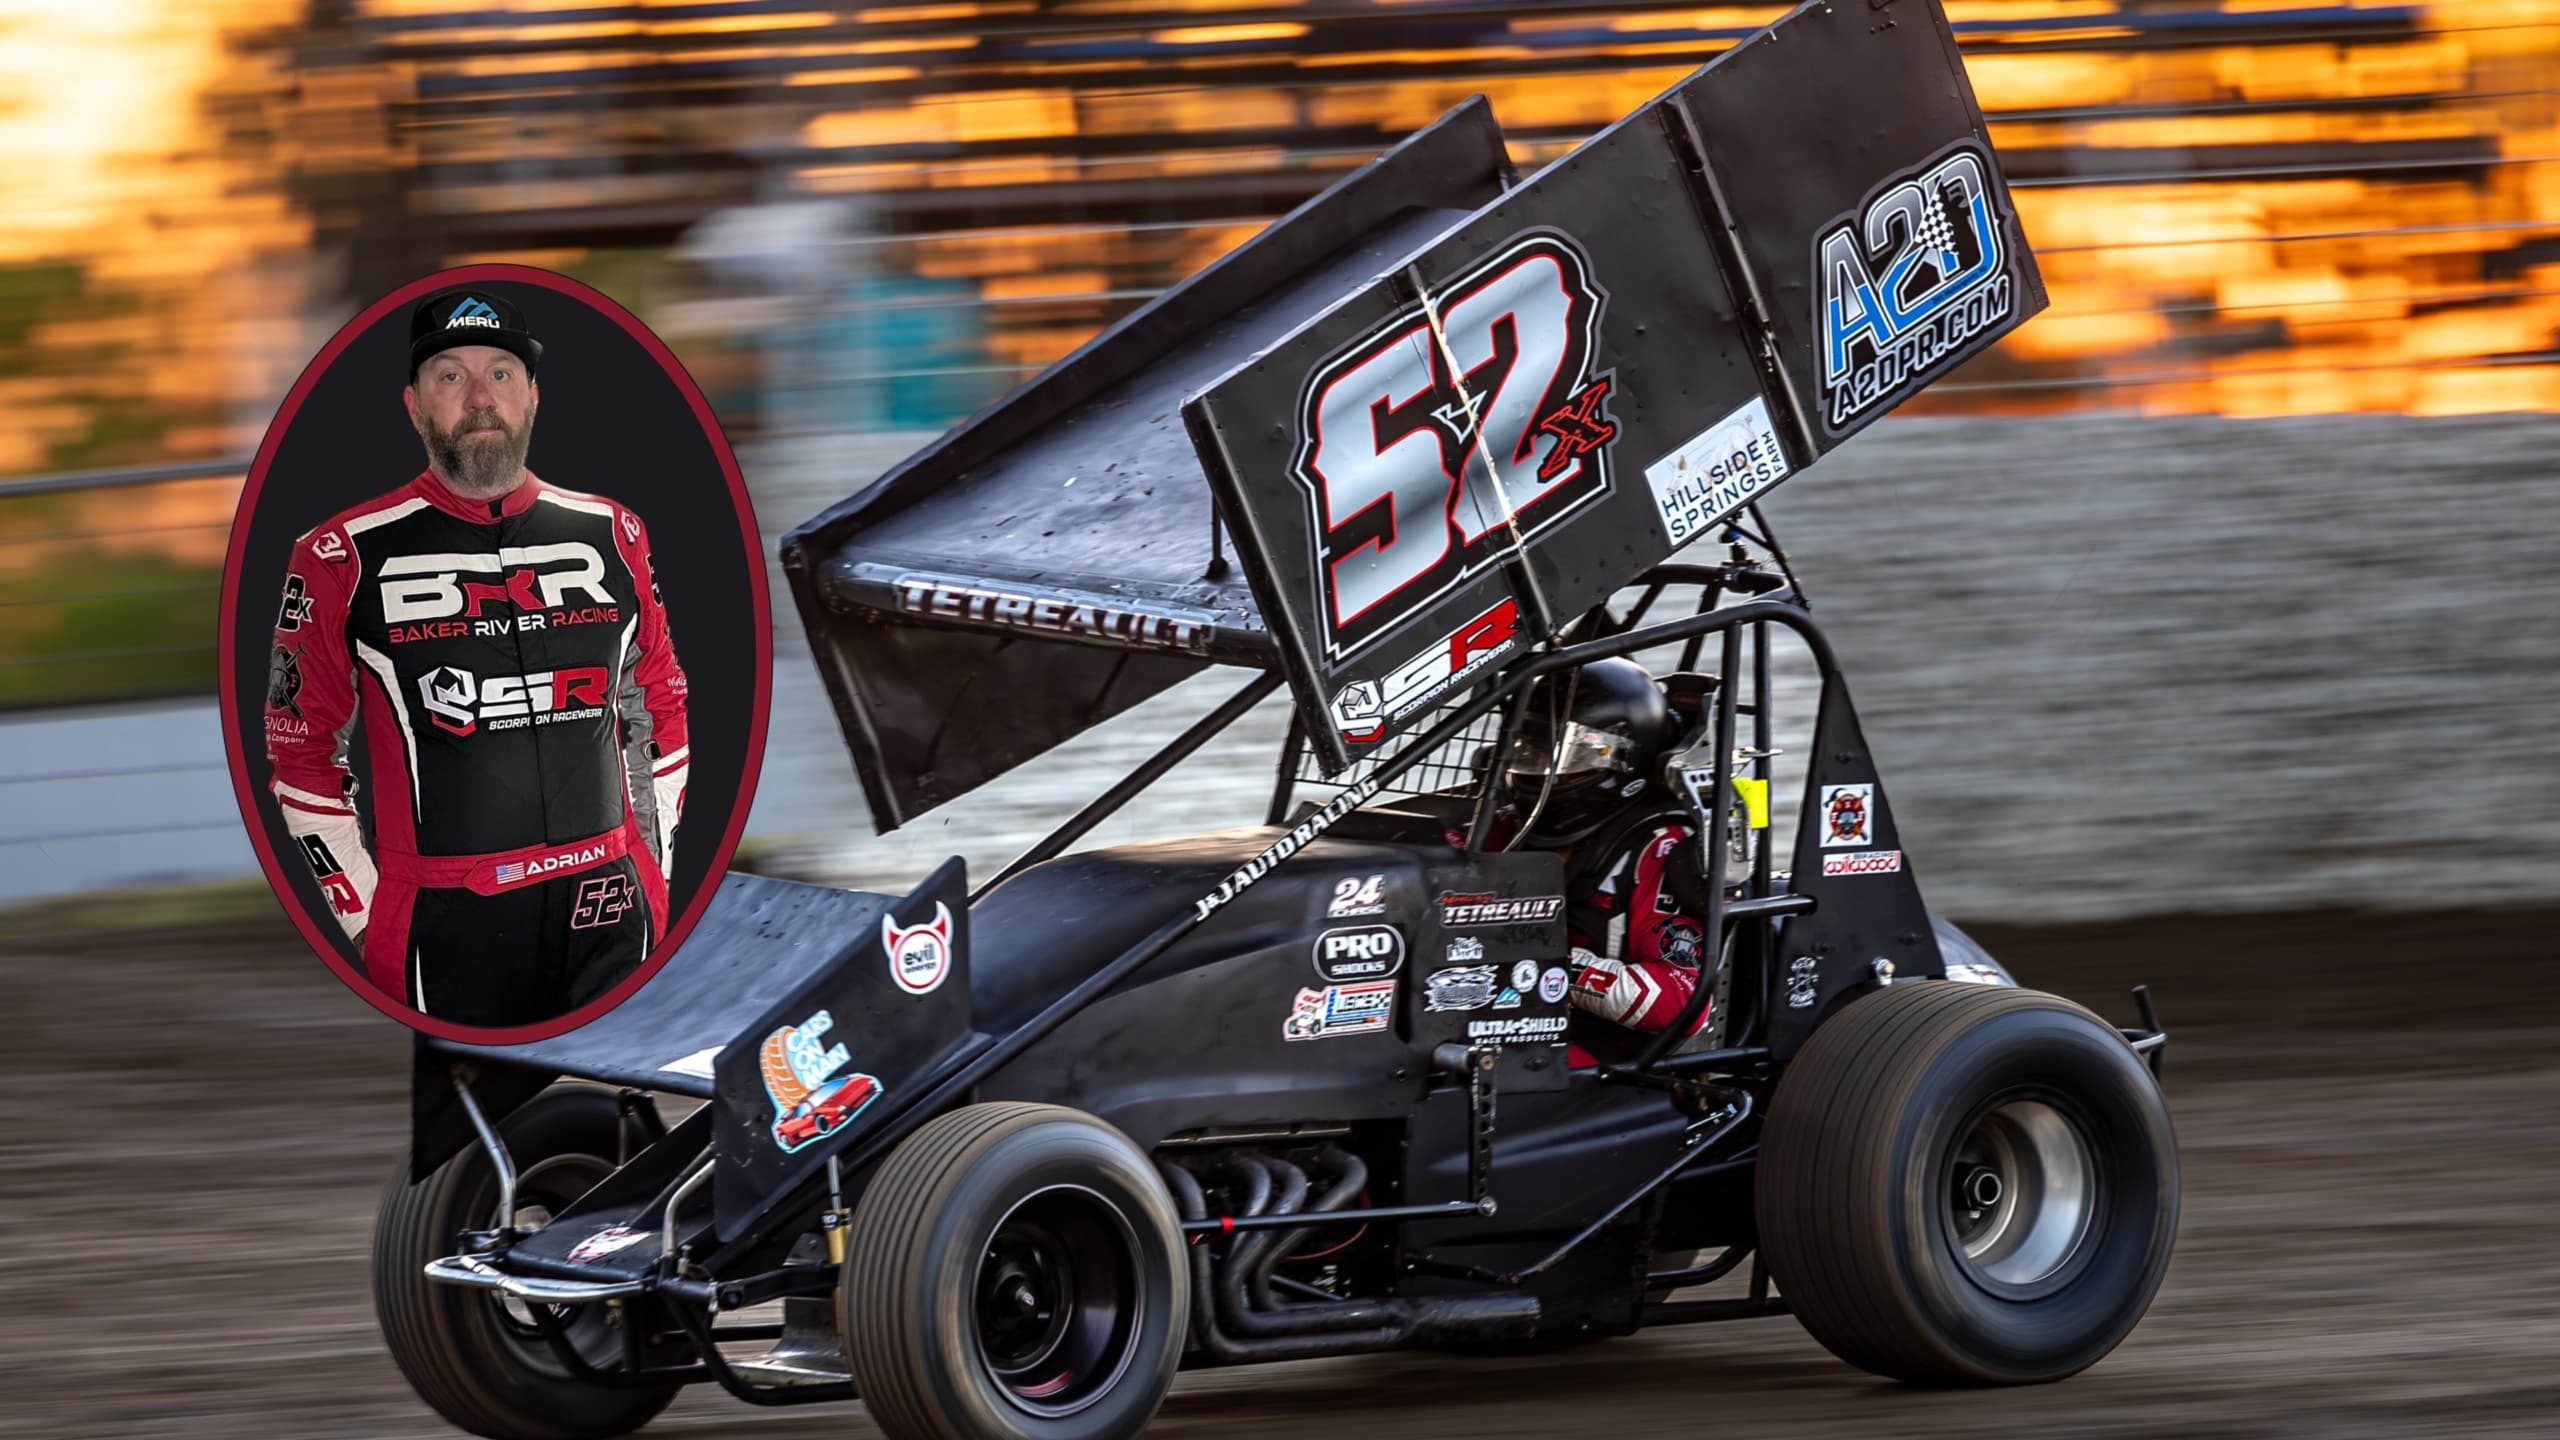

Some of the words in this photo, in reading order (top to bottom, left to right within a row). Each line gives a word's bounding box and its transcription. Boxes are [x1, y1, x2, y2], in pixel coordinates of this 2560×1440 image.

[445, 316, 500, 329] MERU
[1832, 275, 2009, 424] A2DPR.COM
[1762, 431, 1784, 473] FARM
[1662, 440, 1763, 518] HILLSIDE
[1671, 461, 1771, 538] SPRINGS
[389, 621, 469, 644] BAKER
[475, 614, 547, 637] RIVER
[552, 607, 620, 628] RACING
[903, 580, 1208, 648] TETREAULT
[1383, 598, 1519, 716] SR
[479, 667, 608, 718] SR
[1393, 682, 1449, 721] SCORPION
[1450, 639, 1514, 685] RACEWEAR
[271, 733, 306, 744] Company
[489, 714, 550, 731] SCORPION
[552, 708, 603, 723] RACEWEAR
[526, 844, 606, 876] ADRIAN
[1824, 851, 1899, 874] wilwood
[1329, 873, 1386, 913] 24
[1444, 899, 1561, 924] TETREAULT
[904, 943, 936, 967] evil
[1325, 932, 1393, 960] PRO
[795, 1038, 825, 1070] ON
[804, 1043, 851, 1091] MAIN
